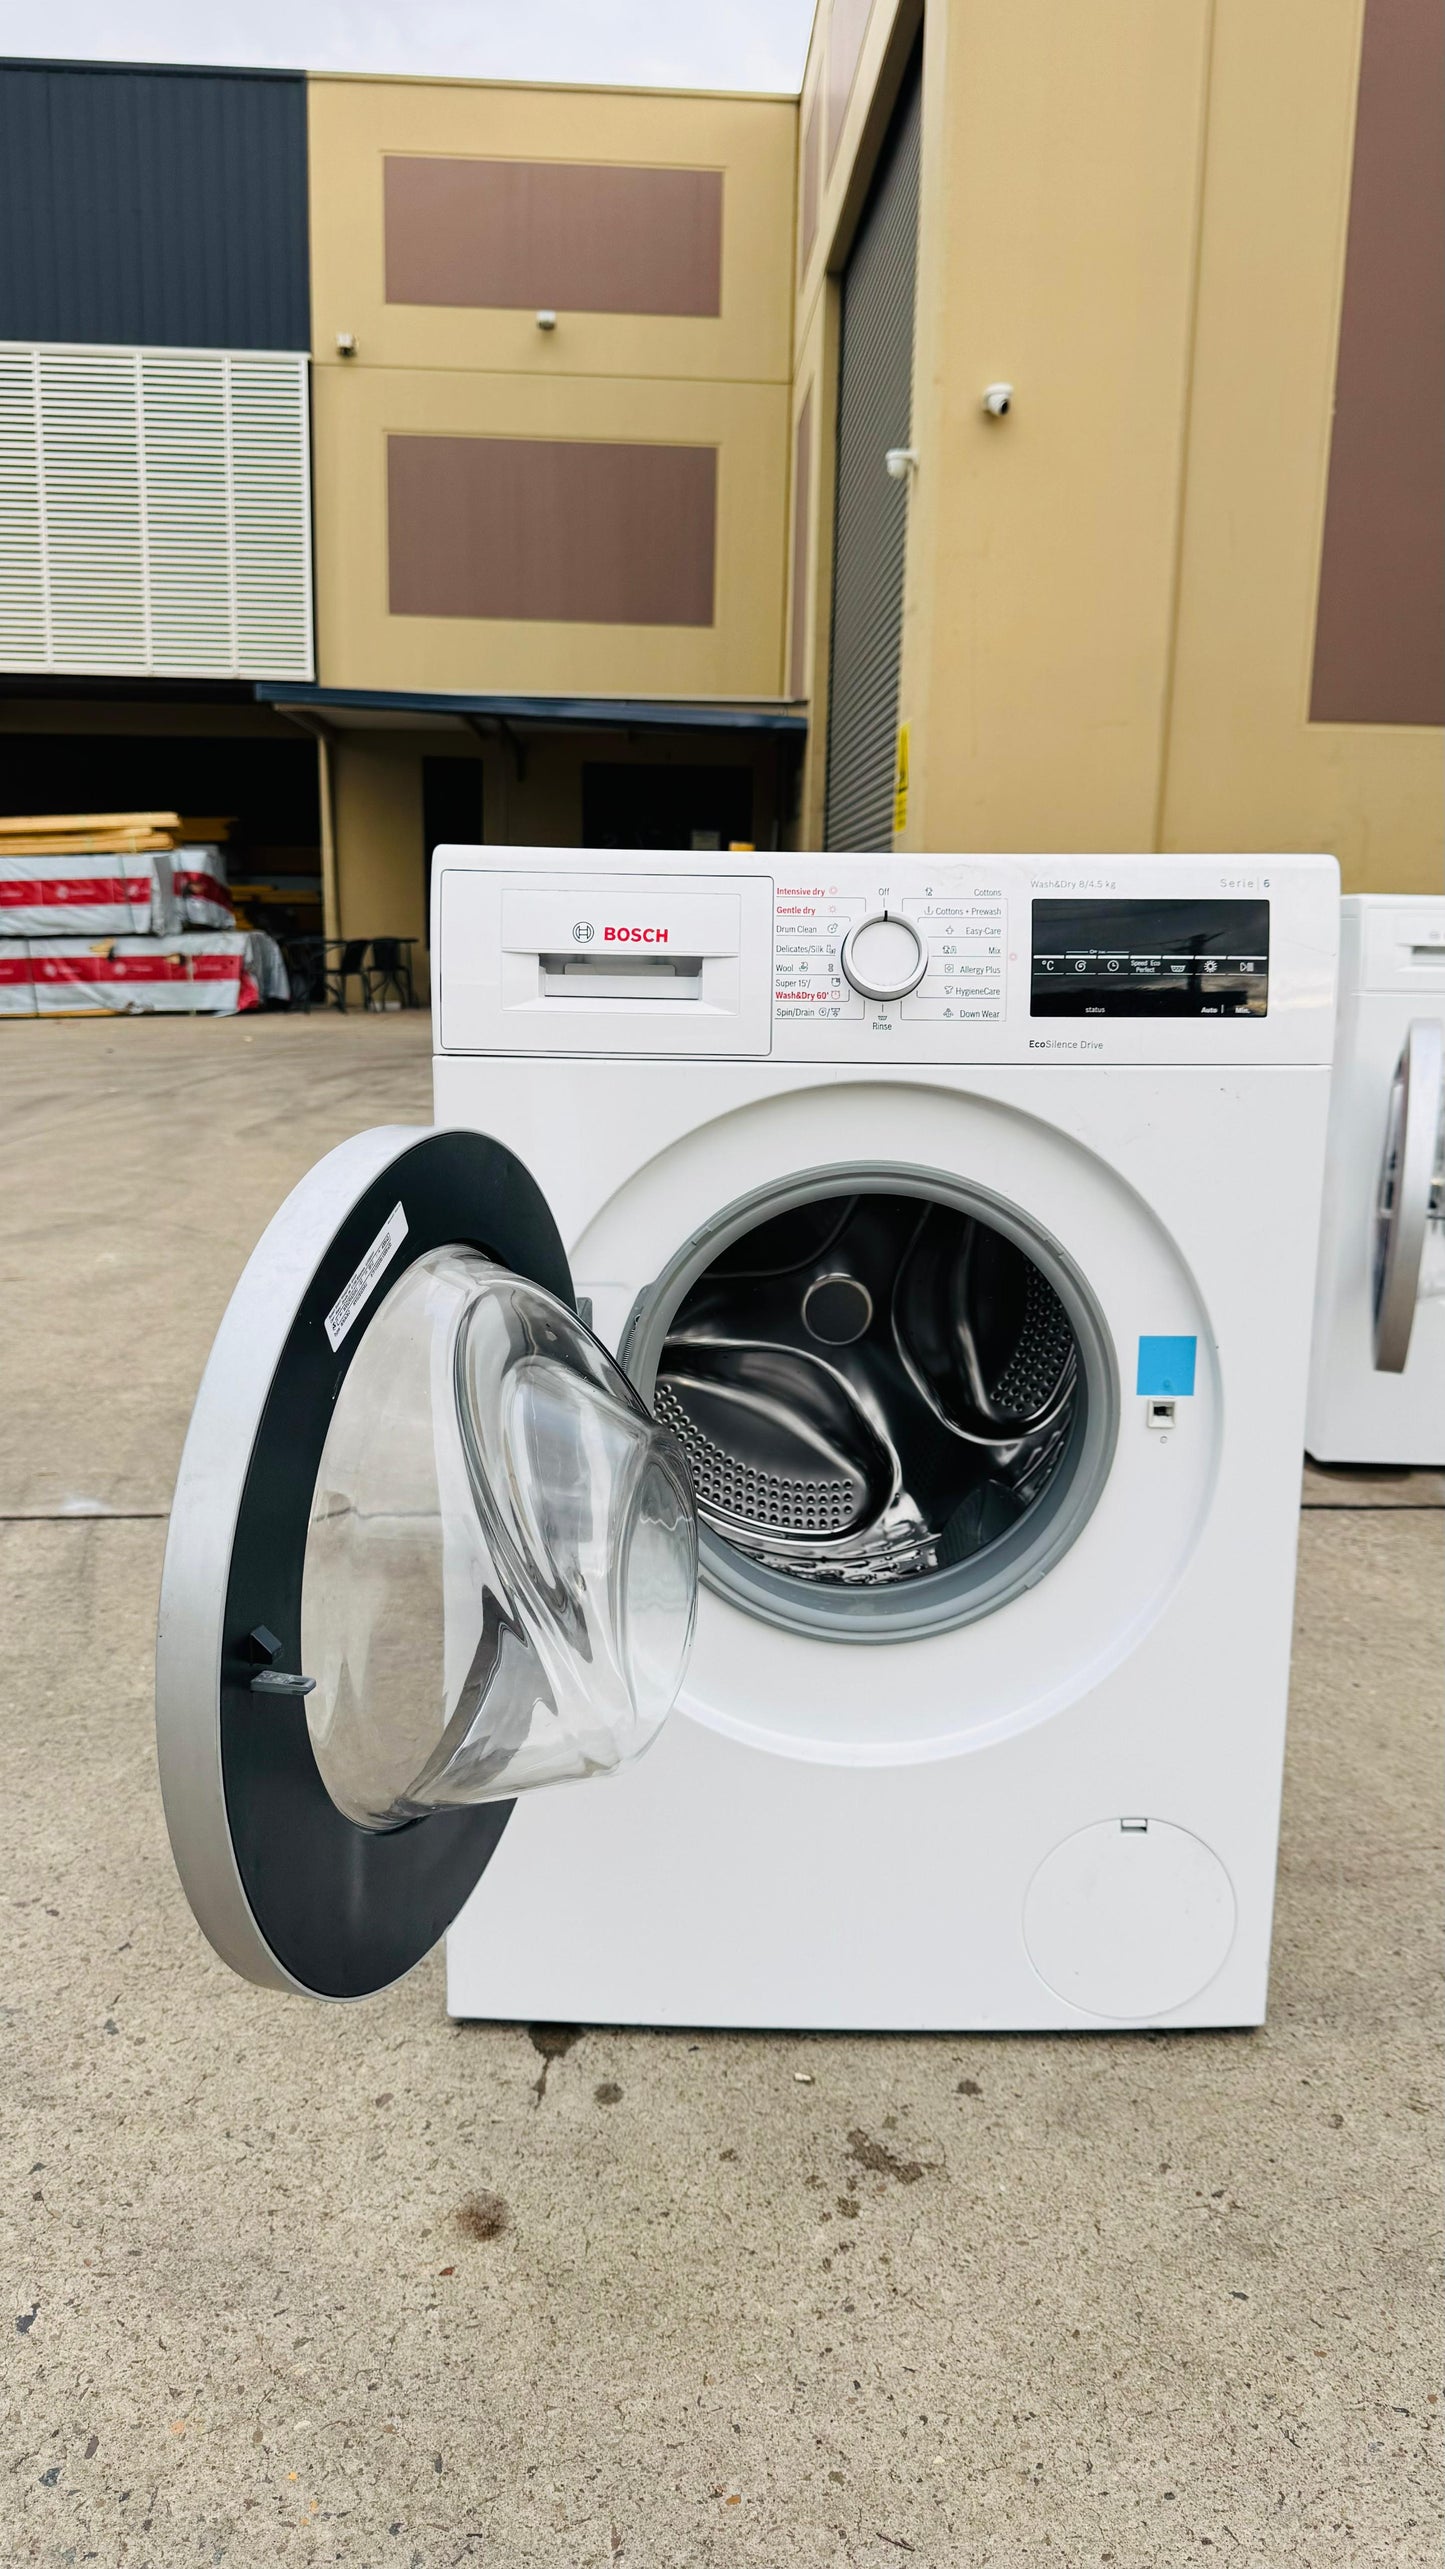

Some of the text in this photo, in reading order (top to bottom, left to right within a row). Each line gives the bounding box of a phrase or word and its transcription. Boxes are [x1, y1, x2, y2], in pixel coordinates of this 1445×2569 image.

[1031, 880, 1076, 889] Wash&Dry
[1220, 878, 1270, 888] Serie 6
[776, 887, 825, 897] Intensive dry
[878, 887, 890, 896] Off
[973, 888, 1002, 896] Cottons
[776, 906, 816, 916] Gentle dry
[935, 907, 963, 915] Cottons
[971, 907, 1001, 916] Prewash
[776, 925, 817, 933] Drum Clean
[965, 927, 1001, 936] Easy-Care
[604, 926, 669, 943] BOSCH
[776, 945, 824, 953] Delicates/Silk
[988, 946, 1001, 954] Mix
[775, 964, 794, 972] Wool
[960, 966, 1001, 975] Allergy Plus
[775, 979, 796, 988] Super
[775, 991, 815, 1001] Wash&Dry
[955, 987, 1000, 996] HygieneCare
[776, 1008, 815, 1017] Spin/Drain
[959, 1010, 1000, 1018] Down Wear
[872, 1022, 892, 1030] Rinse
[1029, 1040, 1104, 1049] EcoSilence Drive
